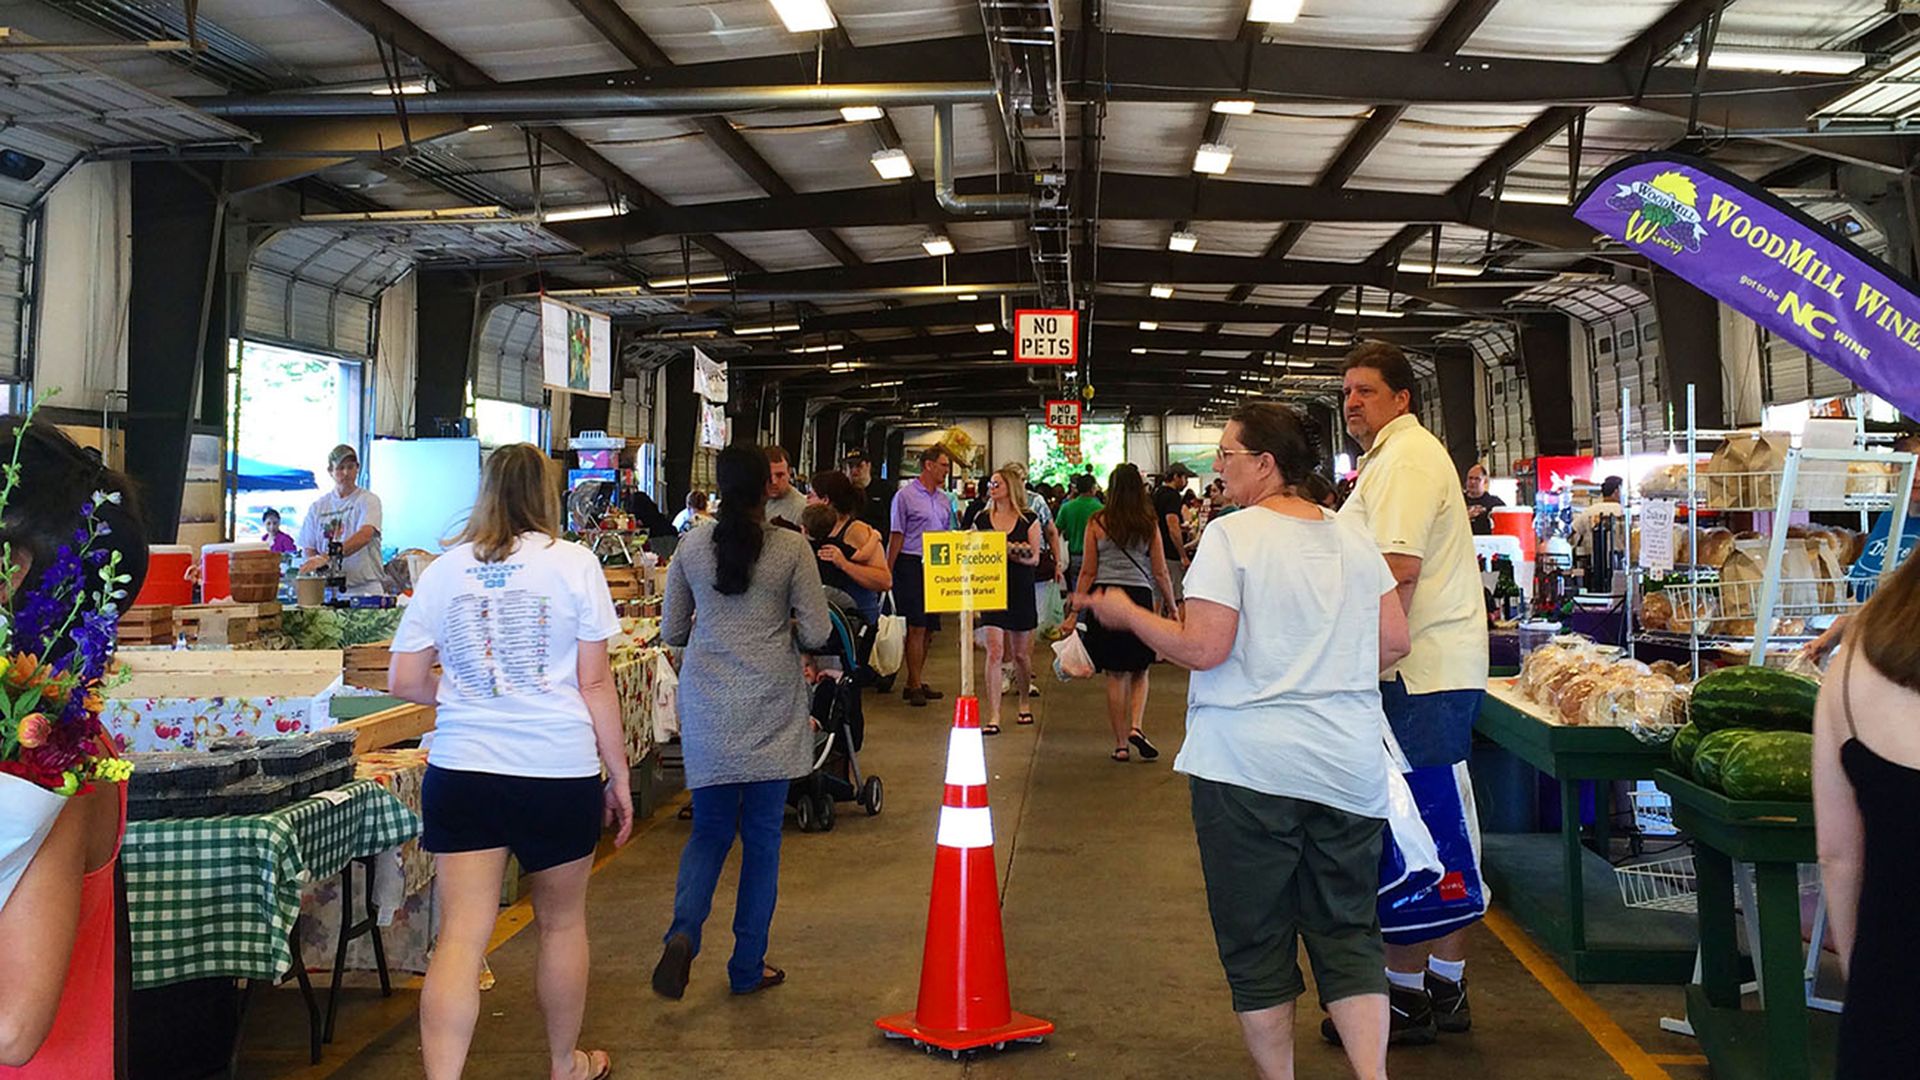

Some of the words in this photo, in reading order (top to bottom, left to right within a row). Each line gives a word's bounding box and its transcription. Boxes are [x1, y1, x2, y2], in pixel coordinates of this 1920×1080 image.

[1739, 274, 1758, 288] got
[1756, 281, 1767, 295] to
[1766, 289, 1780, 302] be
[1776, 290, 1838, 341] NC
[1855, 281, 1920, 351] WINE
[1033, 317, 1057, 334] NO
[1021, 338, 1070, 355] PETS
[1833, 329, 1871, 361] WINE
[1056, 404, 1070, 414] NO
[1050, 414, 1077, 425] PETS
[955, 543, 971, 551] Find
[956, 552, 1002, 565] Facebook
[970, 574, 1001, 583] Regional
[972, 587, 996, 595] Market
